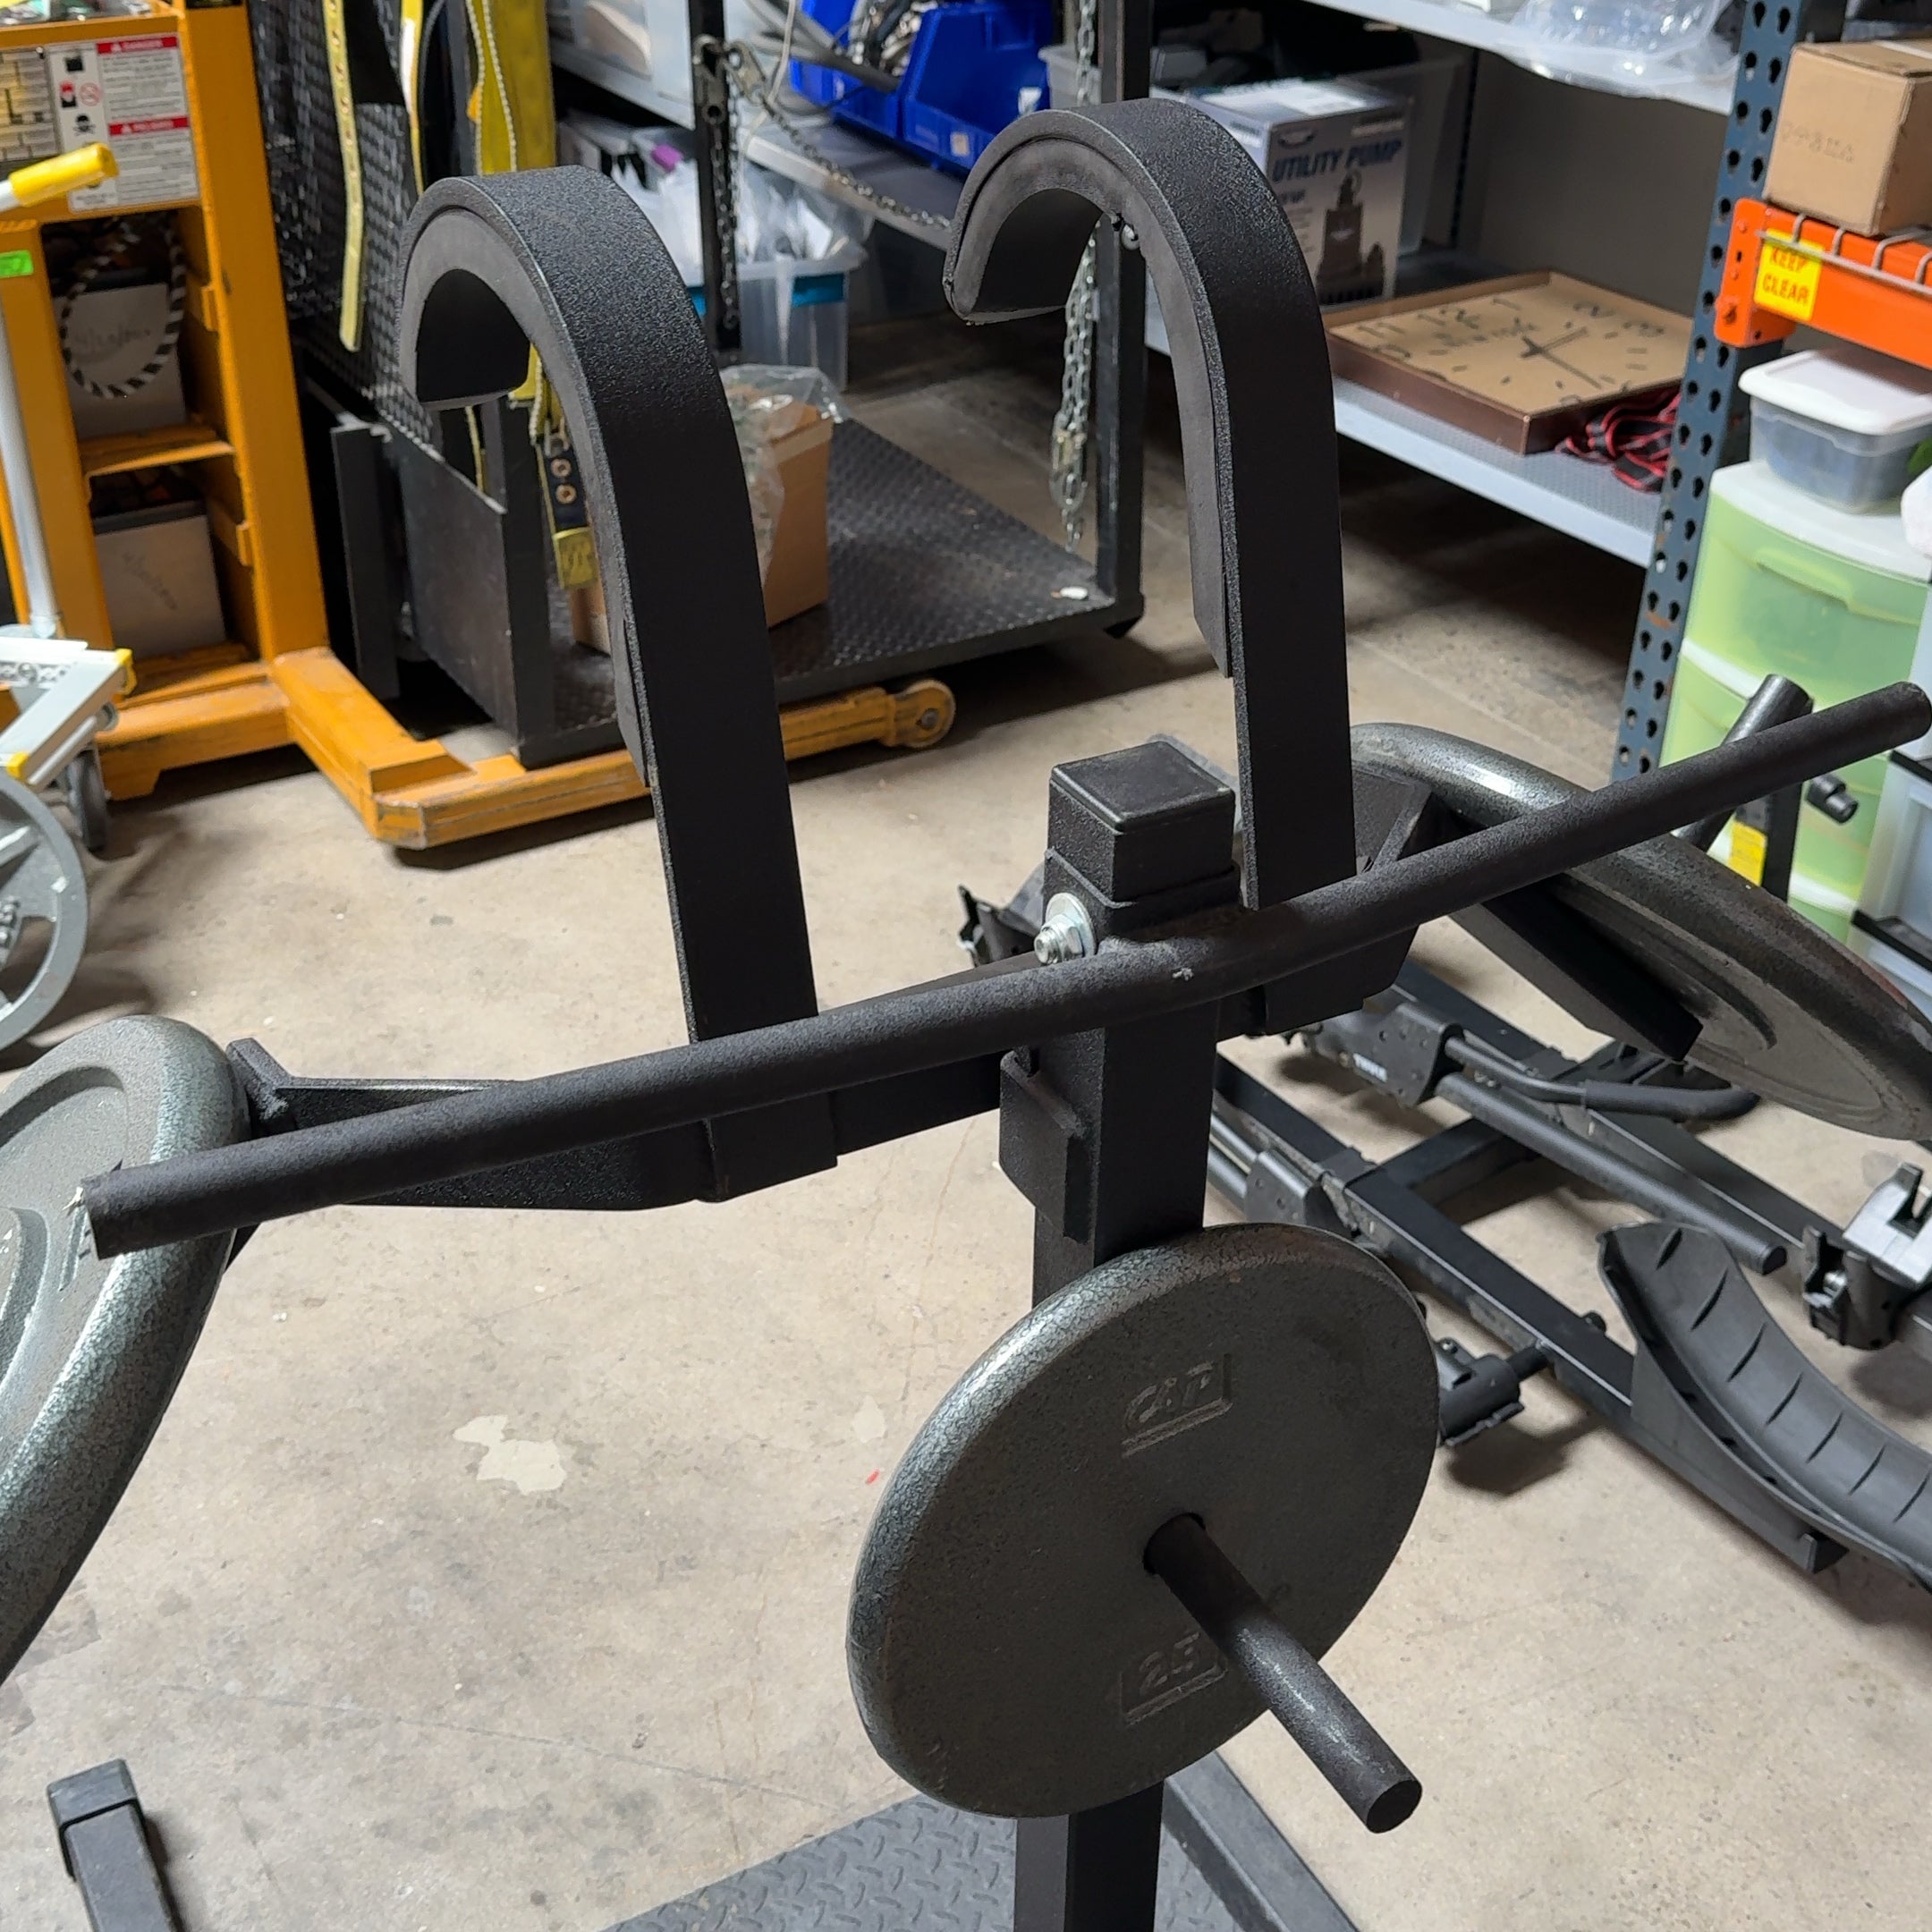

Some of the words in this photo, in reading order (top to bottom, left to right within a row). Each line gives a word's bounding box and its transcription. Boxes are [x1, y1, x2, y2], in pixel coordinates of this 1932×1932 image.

[1272, 148, 1343, 182] UTILITY
[1345, 140, 1402, 168] PUMP
[1769, 246, 1809, 273] KEEP
[1762, 273, 1809, 305] CLEAR
